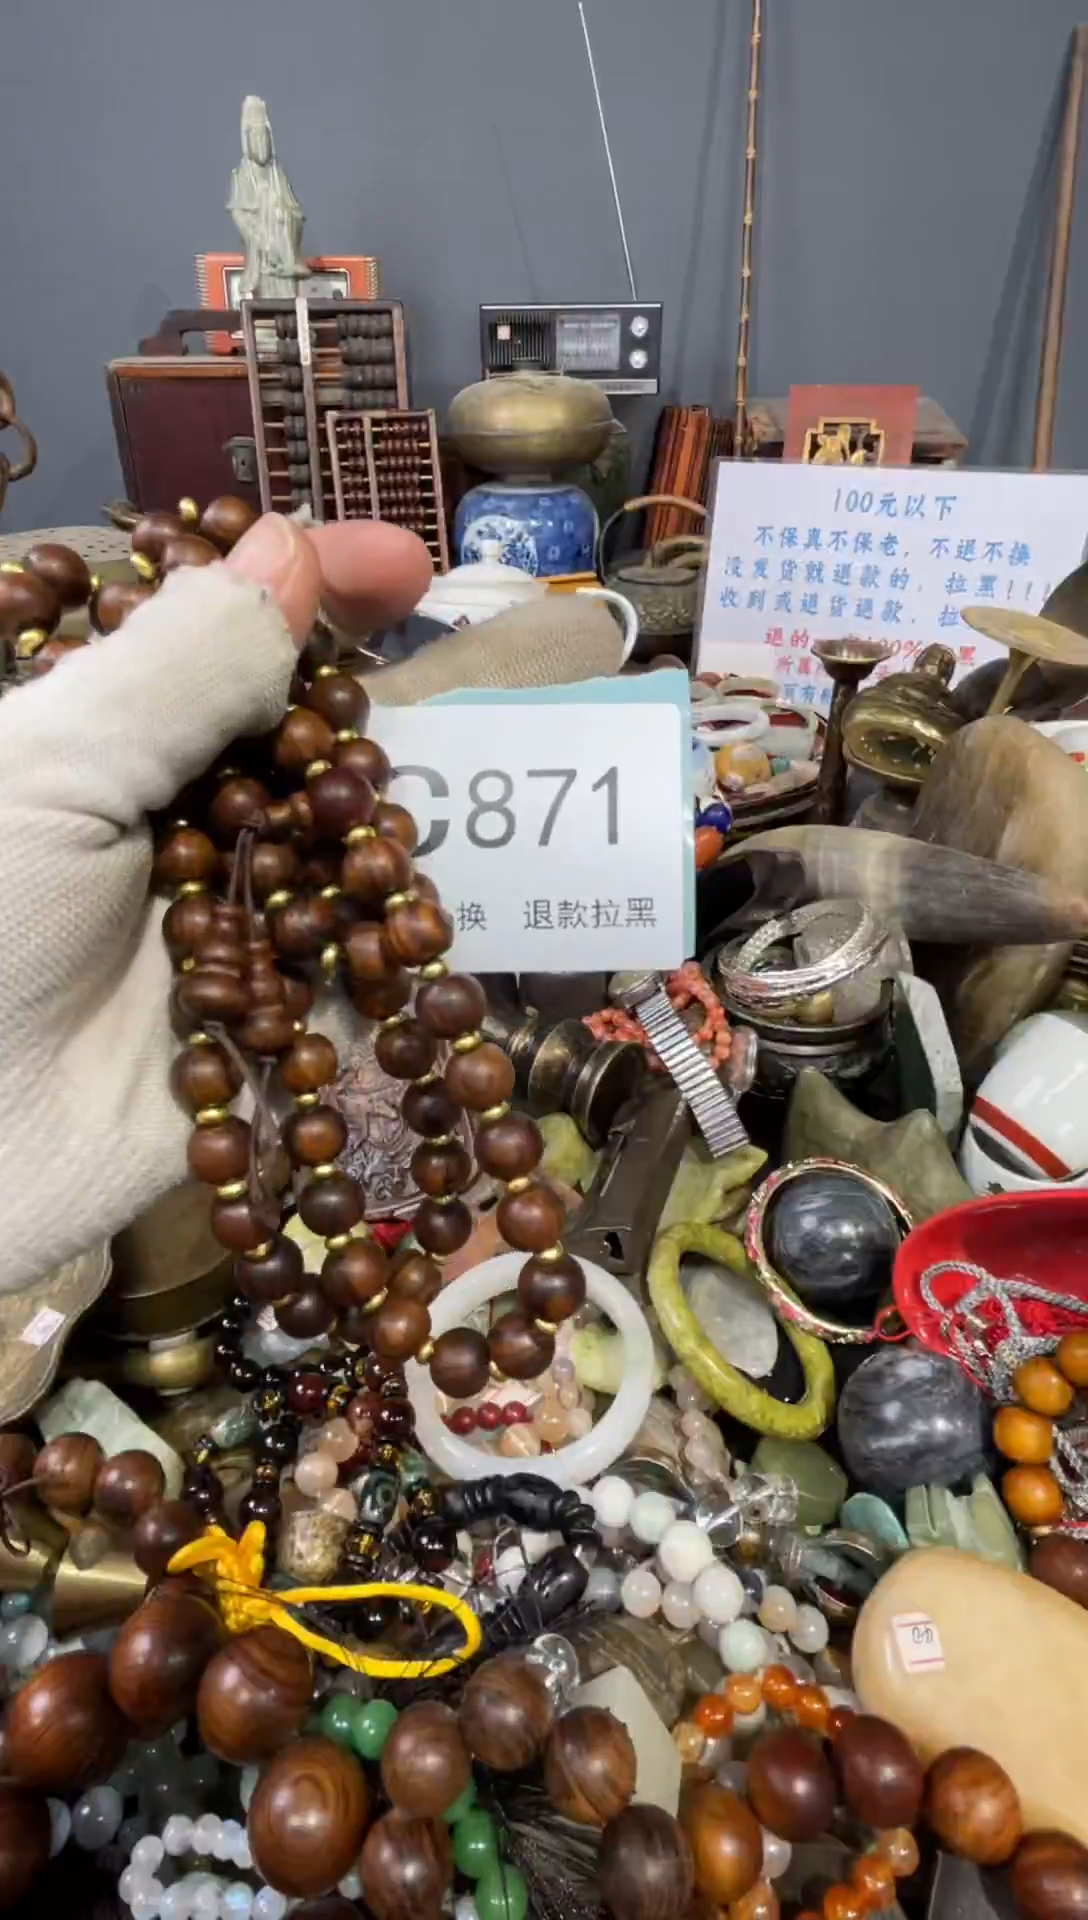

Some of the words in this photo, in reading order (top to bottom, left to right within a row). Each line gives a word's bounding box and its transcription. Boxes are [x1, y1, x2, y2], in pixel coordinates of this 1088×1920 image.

[834, 488, 957, 521] 100元以下
[720, 586, 963, 628] 收到或退货退款，拉
[390, 764, 619, 858] C871
[449, 898, 488, 932] 换
[523, 896, 658, 931] 退款拉黑
